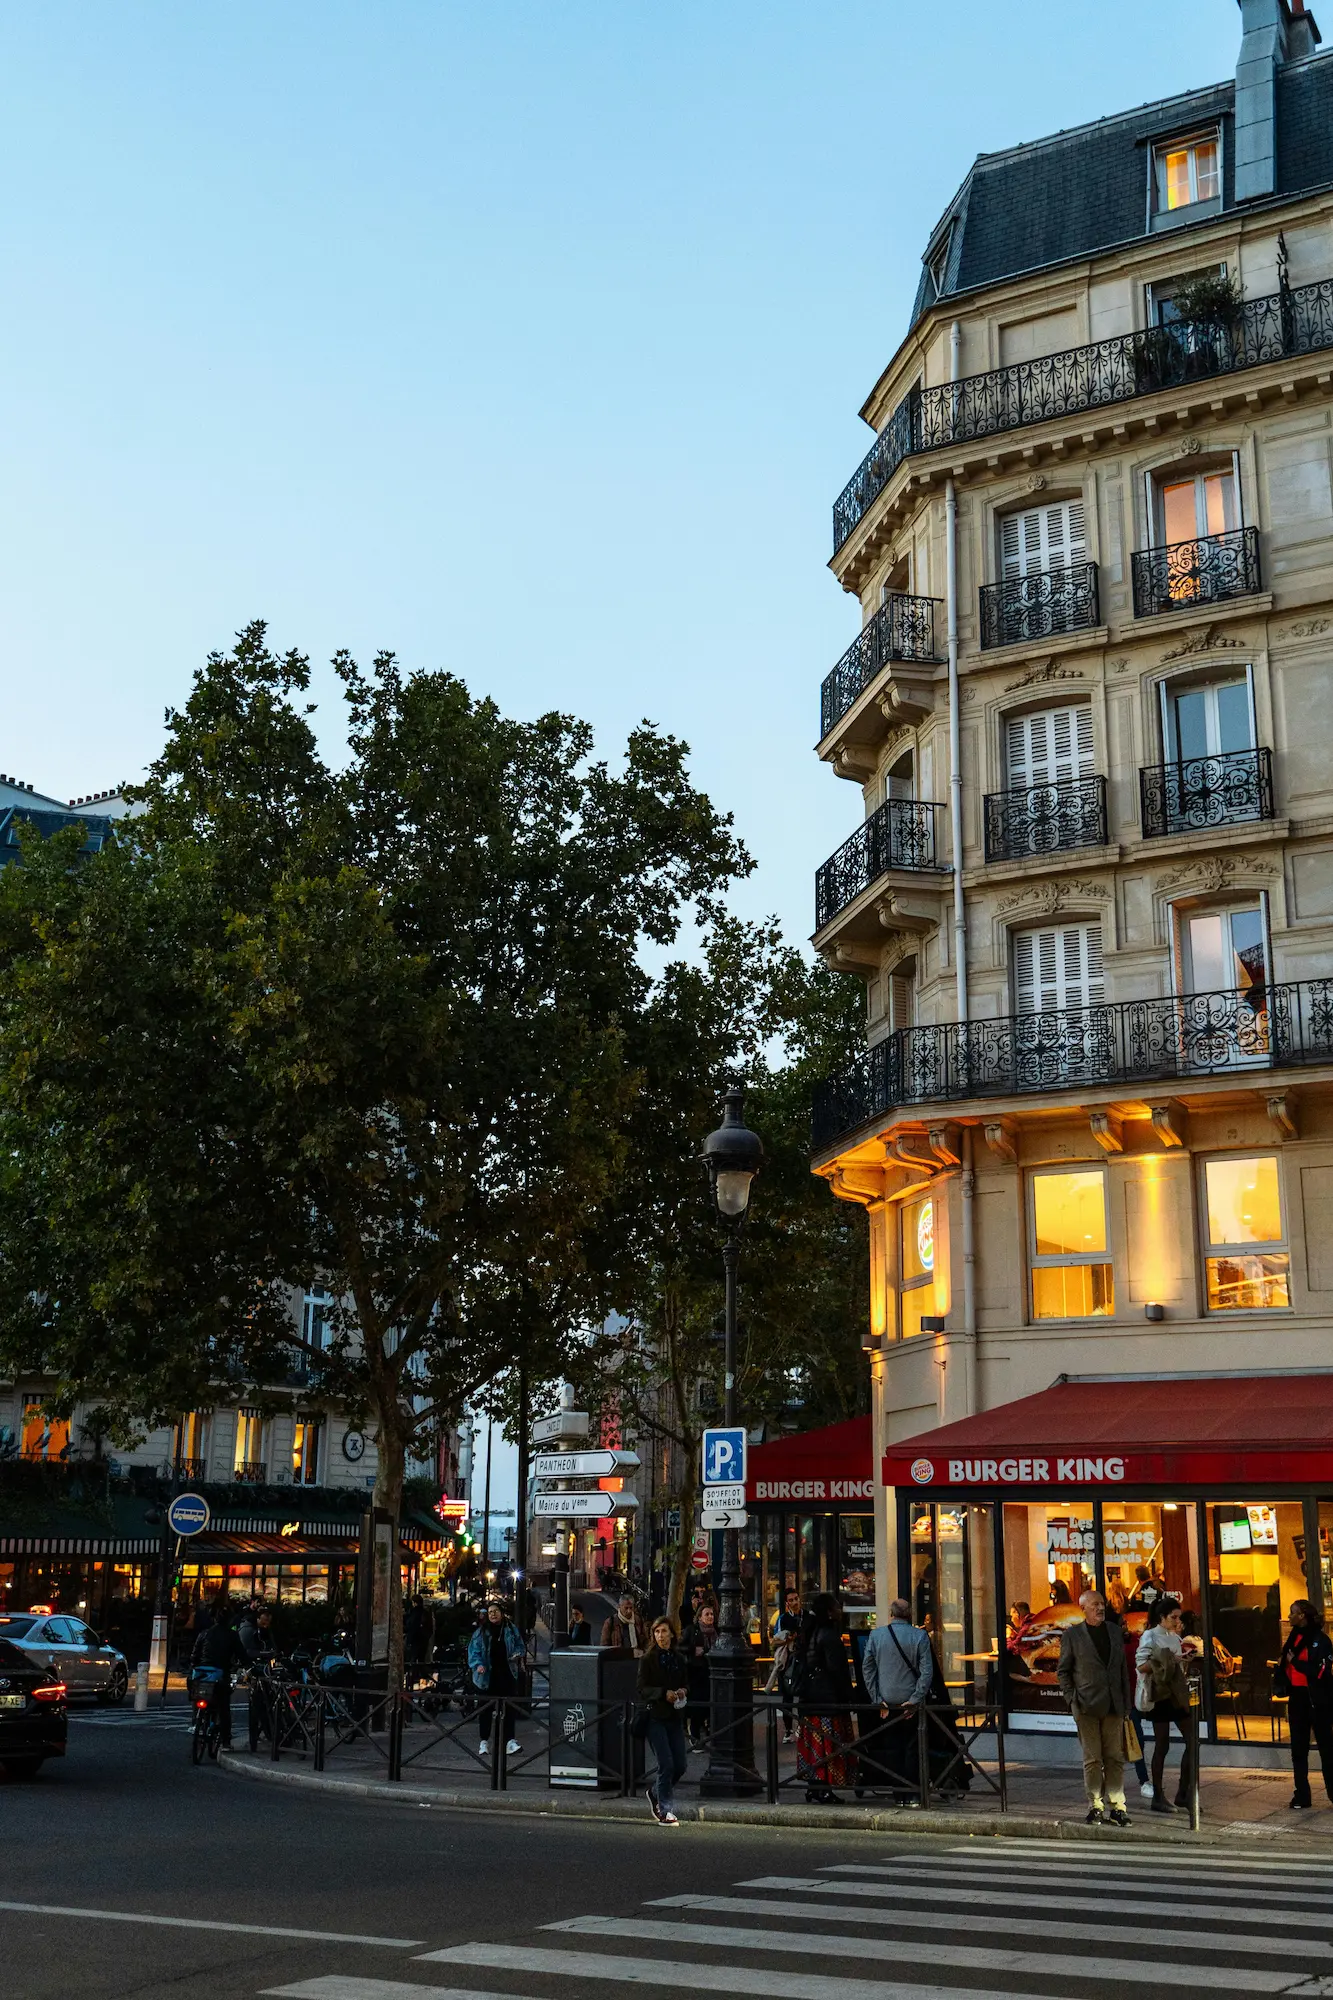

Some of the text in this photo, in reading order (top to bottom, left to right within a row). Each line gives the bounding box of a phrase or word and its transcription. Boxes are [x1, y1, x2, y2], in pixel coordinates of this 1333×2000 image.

[715, 1440, 734, 1473] P
[949, 1457, 1125, 1482] BURGER KING
[756, 1480, 875, 1499] BURGER KING
[538, 1499, 560, 1511] Mairie
[562, 1499, 570, 1510] du
[1069, 1517, 1093, 1529] Les
[1037, 1527, 1156, 1552] Masters
